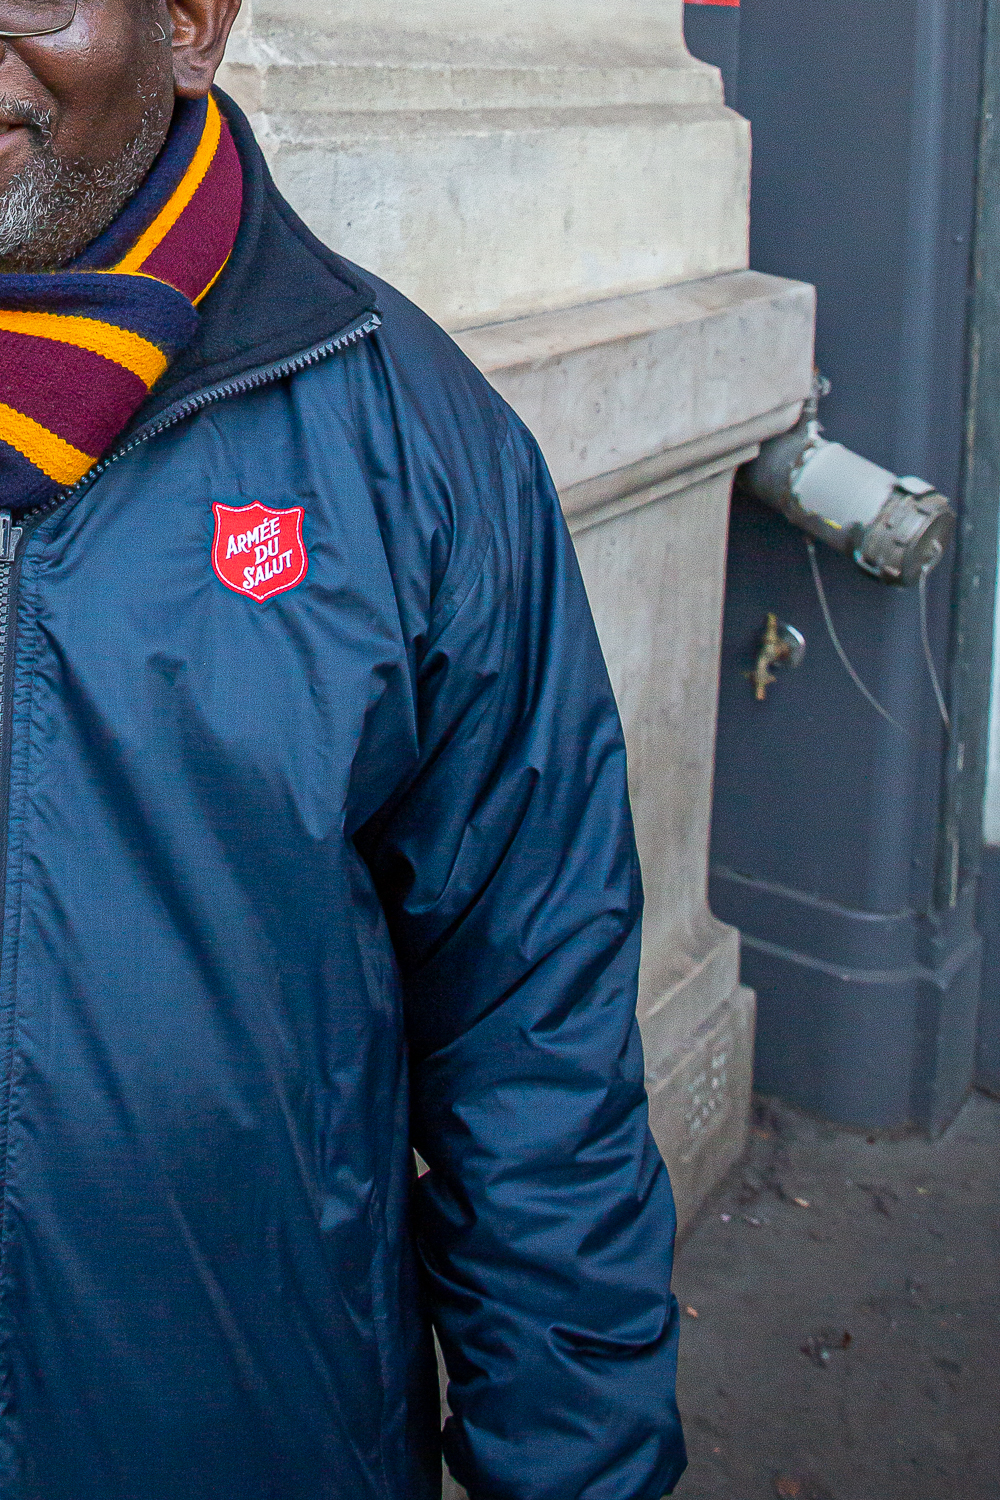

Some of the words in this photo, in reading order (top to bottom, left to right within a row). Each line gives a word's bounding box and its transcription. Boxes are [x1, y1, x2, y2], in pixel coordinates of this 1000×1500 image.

[225, 516, 281, 560] ARMÉE
[254, 536, 279, 566] DU
[242, 548, 293, 590] SALUT
